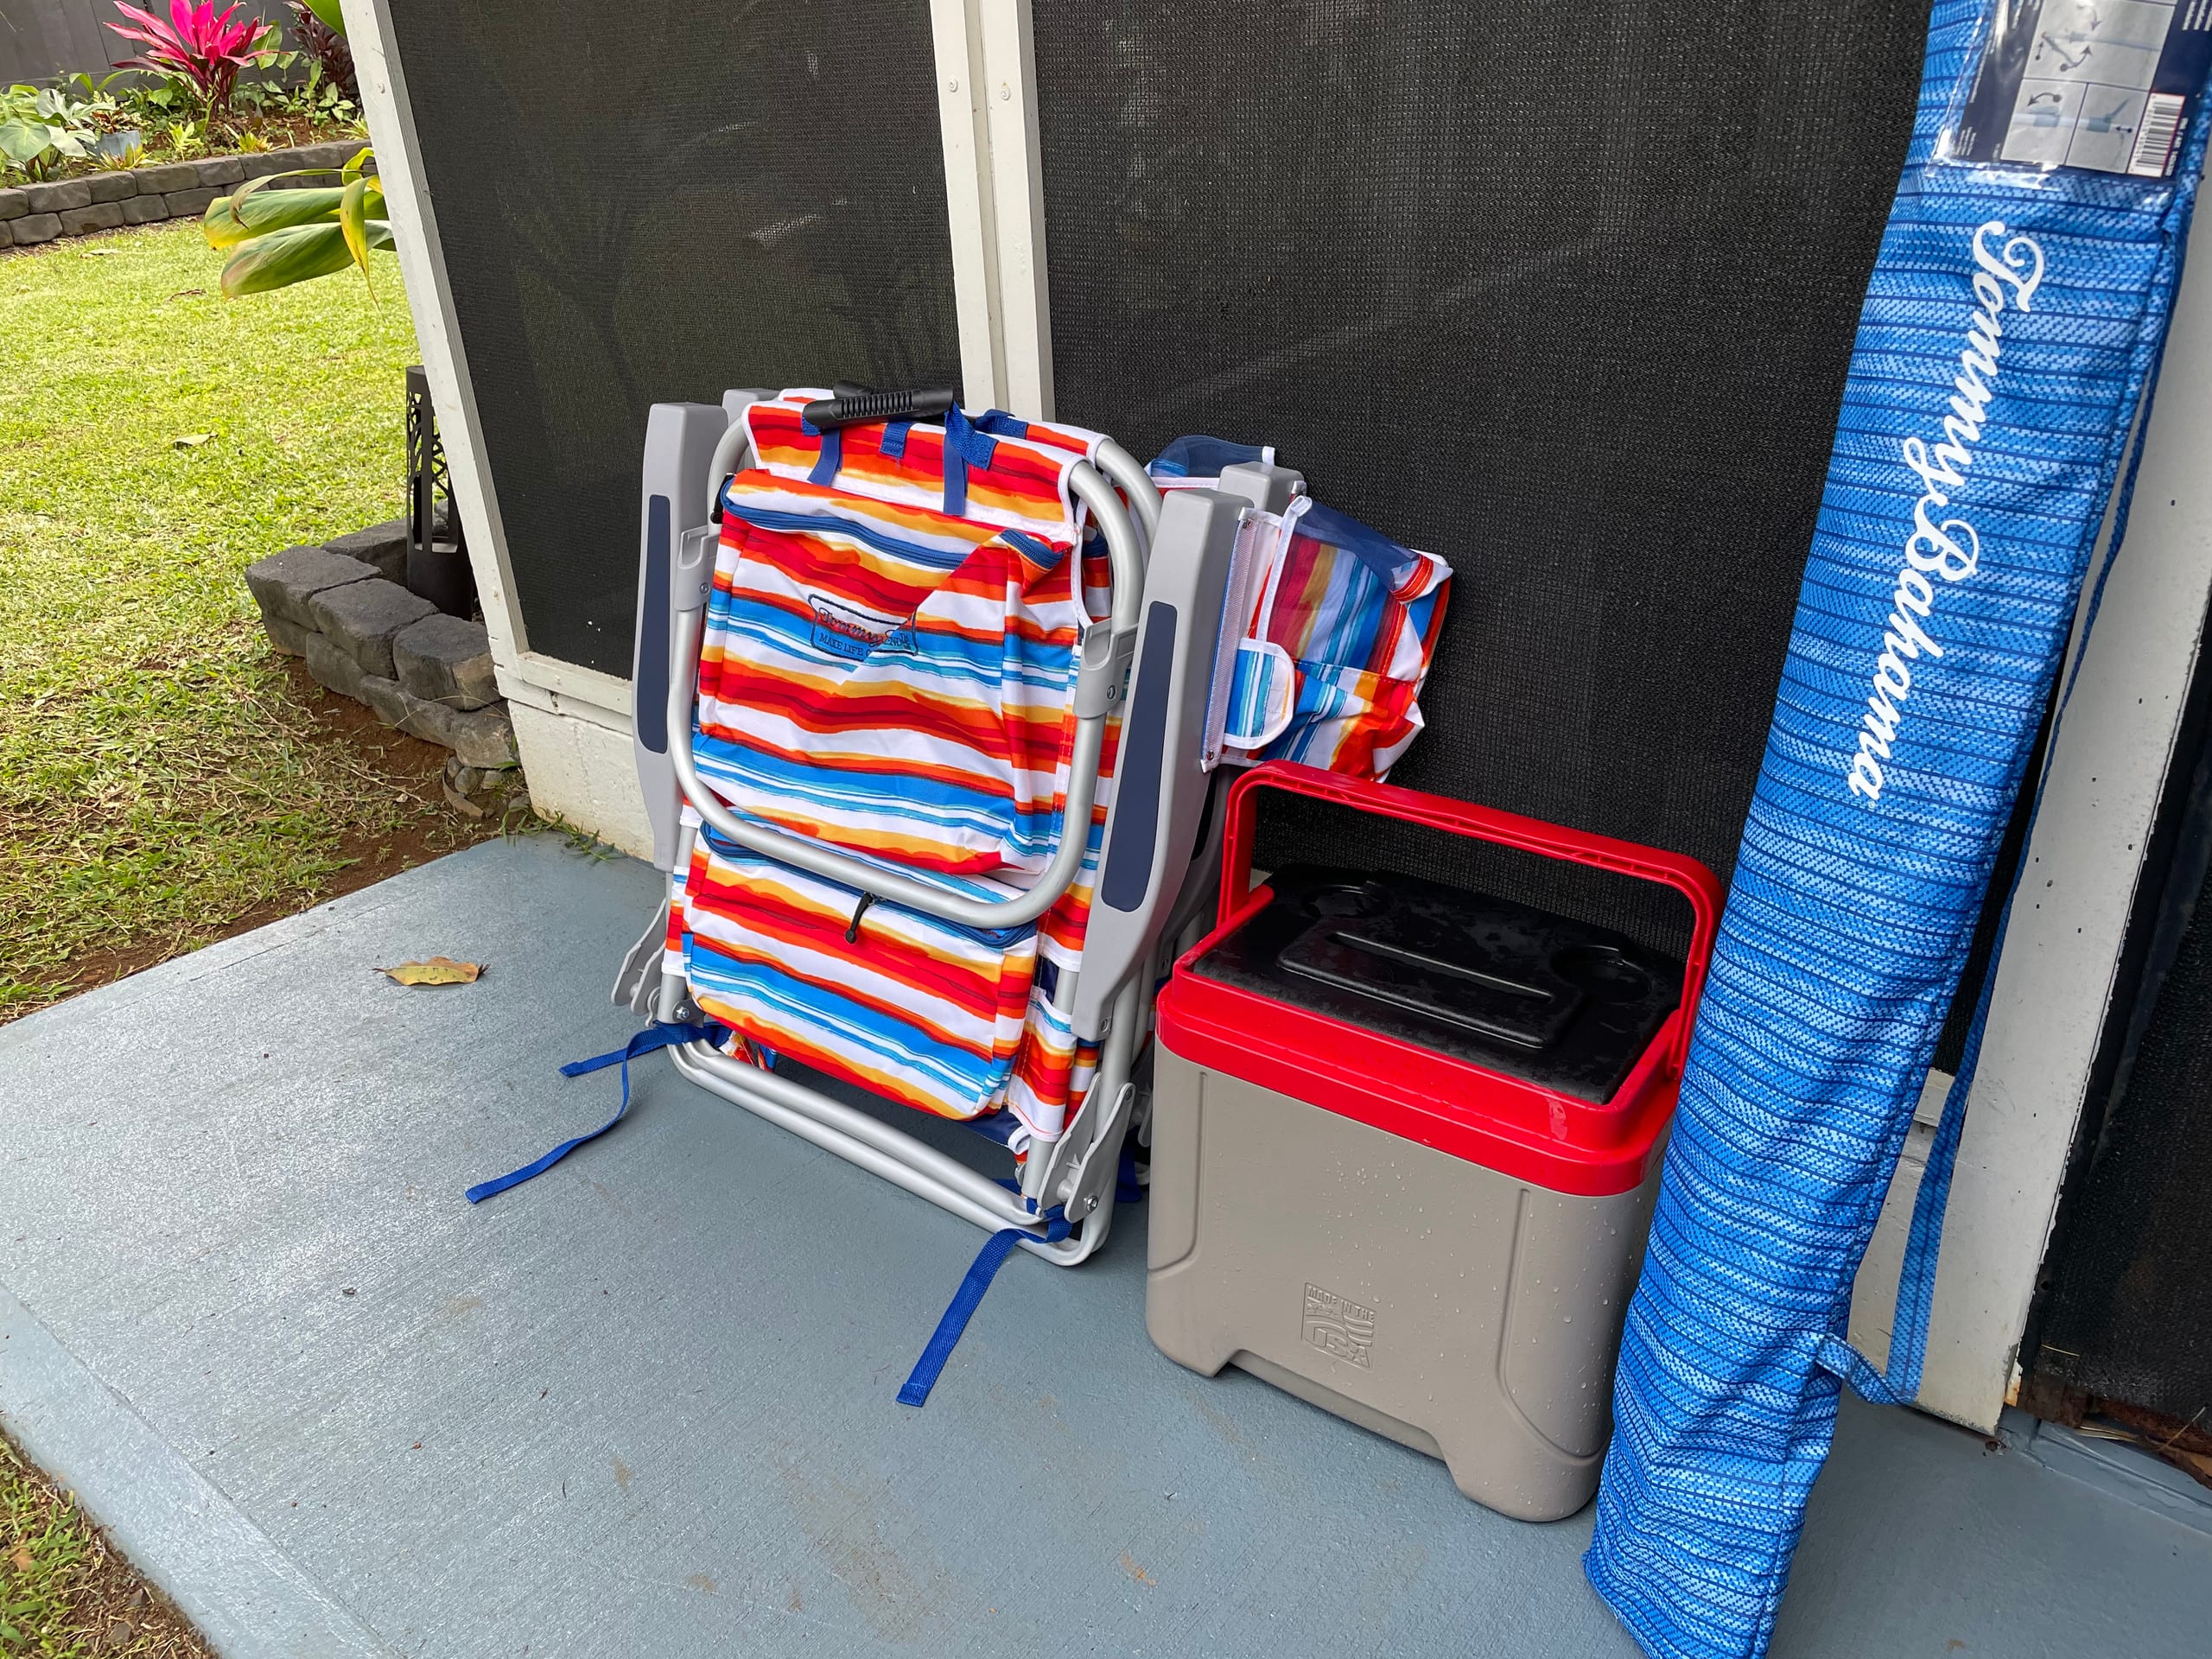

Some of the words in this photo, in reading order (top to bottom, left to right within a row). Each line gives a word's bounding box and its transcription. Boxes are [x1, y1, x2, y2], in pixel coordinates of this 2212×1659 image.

[1904, 221, 2044, 498] Tommy
[818, 607, 884, 647] Tommy
[819, 632, 842, 652] MAKE
[844, 643, 864, 657] LIFE
[1848, 492, 1980, 801] Bahama
[1307, 1285, 1338, 1305] MADE
[1341, 1299, 1352, 1314] IN
[1354, 1306, 1376, 1324] THE
[1306, 1324, 1370, 1368] USA
